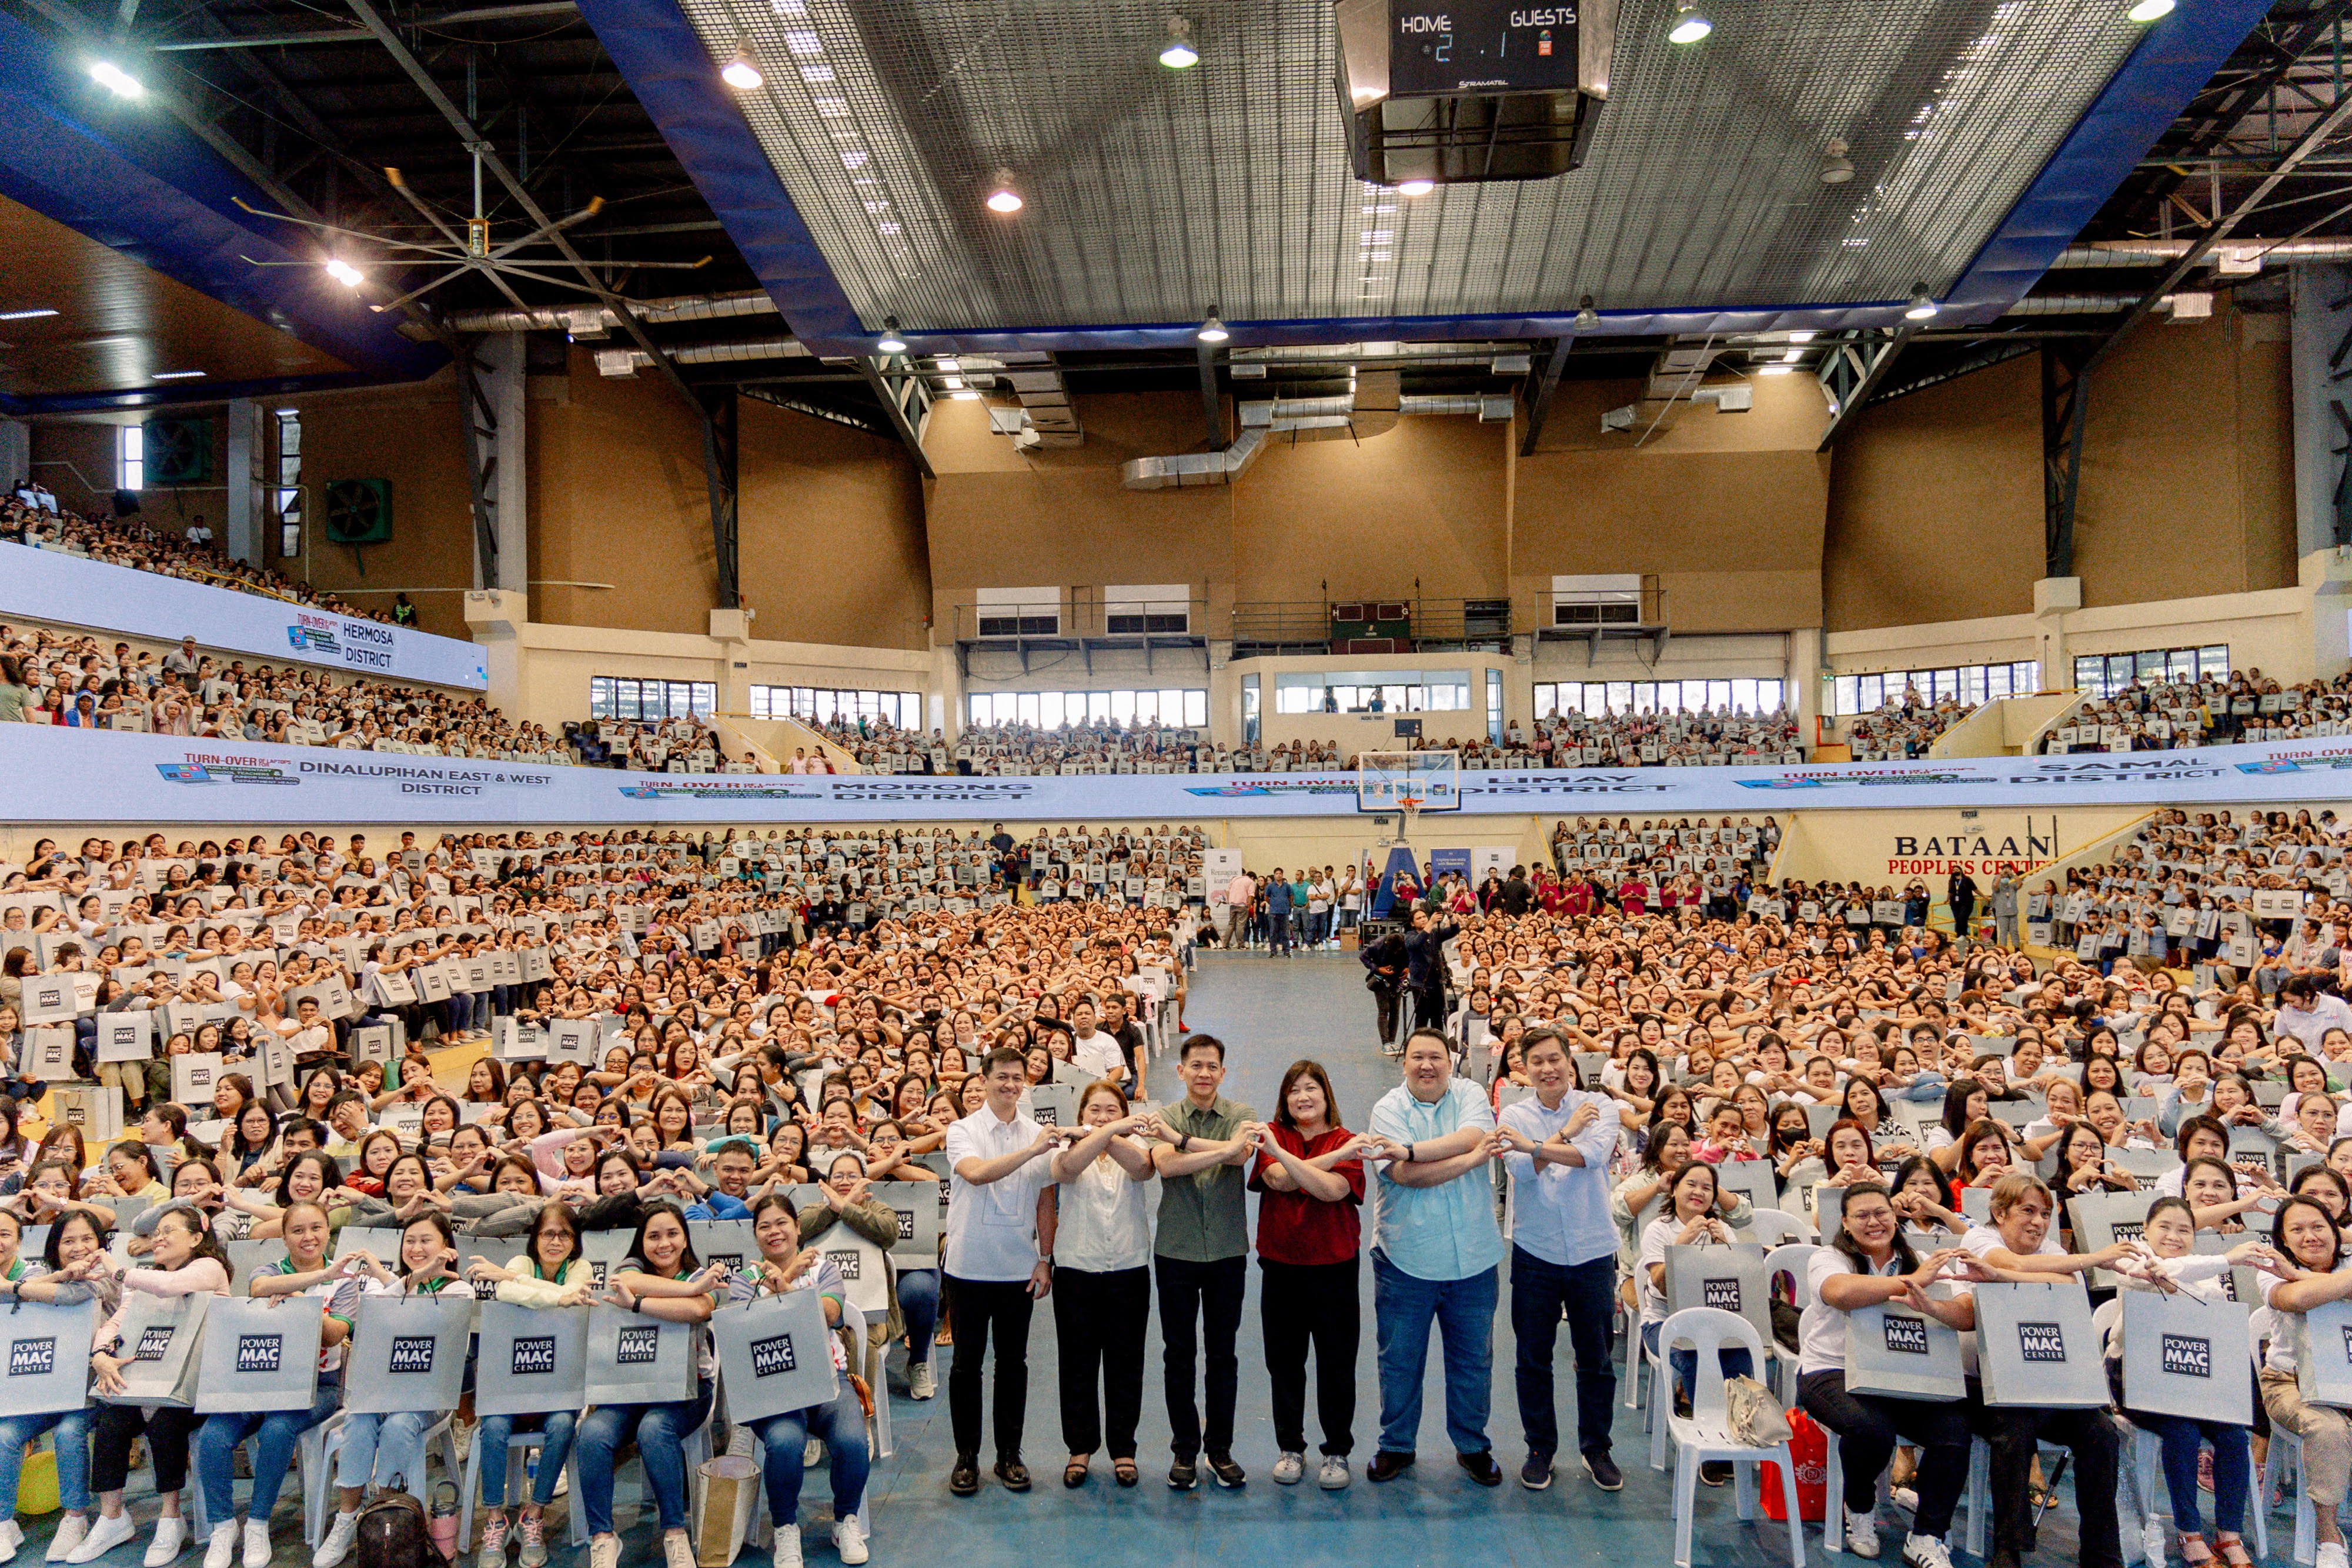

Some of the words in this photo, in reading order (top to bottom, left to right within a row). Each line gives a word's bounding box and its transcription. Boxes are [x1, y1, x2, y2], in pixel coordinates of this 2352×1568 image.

[1511, 8, 1577, 27] GUESTS
[1402, 15, 1451, 33] HOME
[1458, 79, 1508, 88] STRAMATEL
[343, 622, 394, 646] HERMOSA
[346, 647, 392, 668] DISTRICT
[184, 753, 257, 766] TURN-OVER
[2268, 748, 2352, 760] TURN-OV
[2037, 758, 2209, 771] SAMAL
[300, 761, 443, 780] DINALUPIHAN
[449, 771, 491, 781] EAST
[496, 774, 505, 783] &
[510, 774, 552, 784] WEST
[1783, 769, 1905, 778] TURN-OVER
[2010, 768, 2226, 783] DISTRICT
[1489, 775, 1642, 784] LIMAY
[401, 783, 482, 795] DISTRICT
[1451, 785, 1676, 794] DISTRICT
[1895, 837, 2051, 856] BATAAN
[1888, 860, 1975, 875] PEOPLE'S
[898, 1222, 912, 1232] AC
[2113, 1225, 2144, 1234] POWER
[827, 1253, 857, 1262] POWER
[1706, 1282, 1738, 1292] POWER
[1707, 1292, 1739, 1303] MAC
[1886, 1319, 1922, 1330] POWER
[145, 1328, 172, 1339] POWER
[621, 1330, 656, 1339] POWER
[1887, 1329, 1924, 1343] MAC
[2021, 1326, 2059, 1336] POWER
[14, 1341, 52, 1352] POWER
[139, 1339, 169, 1352] MAC
[241, 1339, 279, 1348] POWER
[395, 1340, 432, 1350] POWER
[517, 1341, 553, 1351] POWER
[620, 1340, 656, 1353] MAC
[753, 1338, 789, 1354] POWER
[1889, 1342, 1926, 1351] CENTER
[2024, 1338, 2062, 1350] MAC
[2164, 1339, 2207, 1352] POWER
[12, 1350, 52, 1365] MAC
[239, 1349, 278, 1362] MAC
[393, 1350, 432, 1363] MAC
[516, 1351, 553, 1365] MAC
[757, 1348, 792, 1367] MAC
[2165, 1349, 2208, 1366] MAC
[11, 1363, 51, 1372] CENTER
[757, 1363, 793, 1375] CENTER
[2164, 1363, 2208, 1374] CENTER
